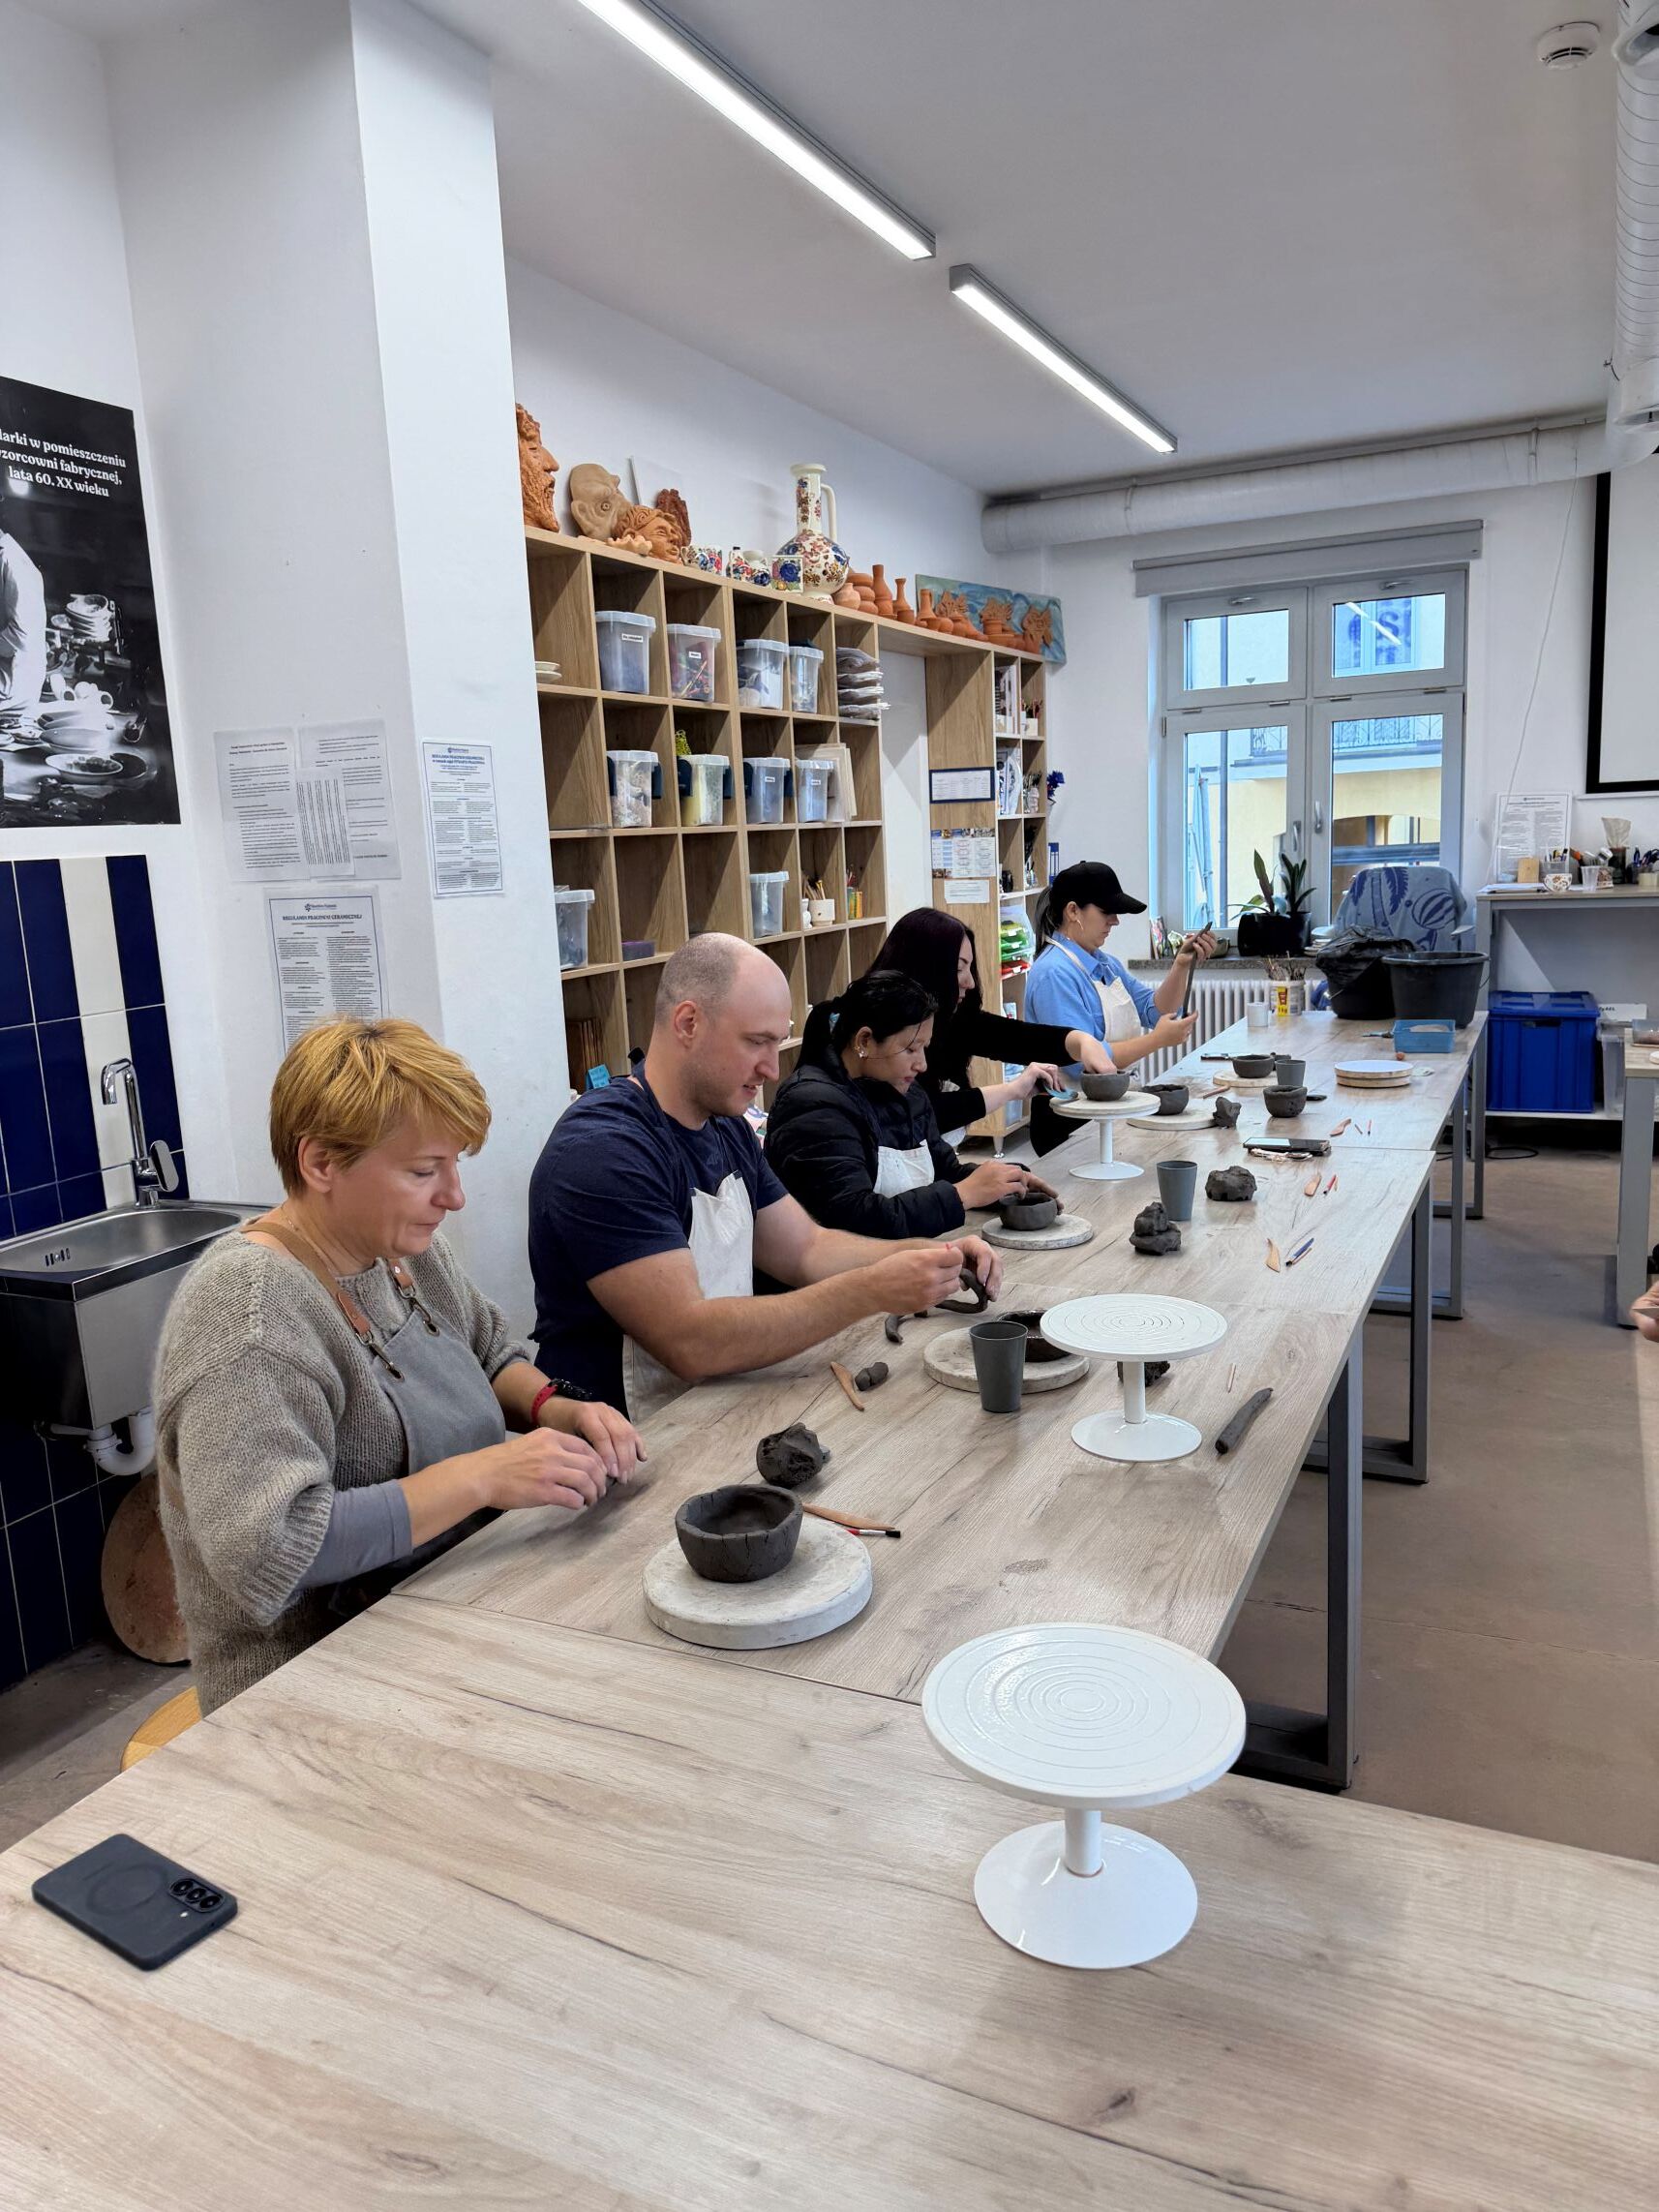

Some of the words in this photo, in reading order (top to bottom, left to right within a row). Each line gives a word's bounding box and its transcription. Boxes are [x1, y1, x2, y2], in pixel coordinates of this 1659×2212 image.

[29, 438, 41, 449] w
[43, 440, 127, 469] pomieszczeniu
[9, 465, 34, 483] lata
[35, 471, 55, 487] 60.
[55, 475, 74, 490] XX
[74, 481, 109, 498] wieku
[59, 459, 123, 485] fabrycznej,
